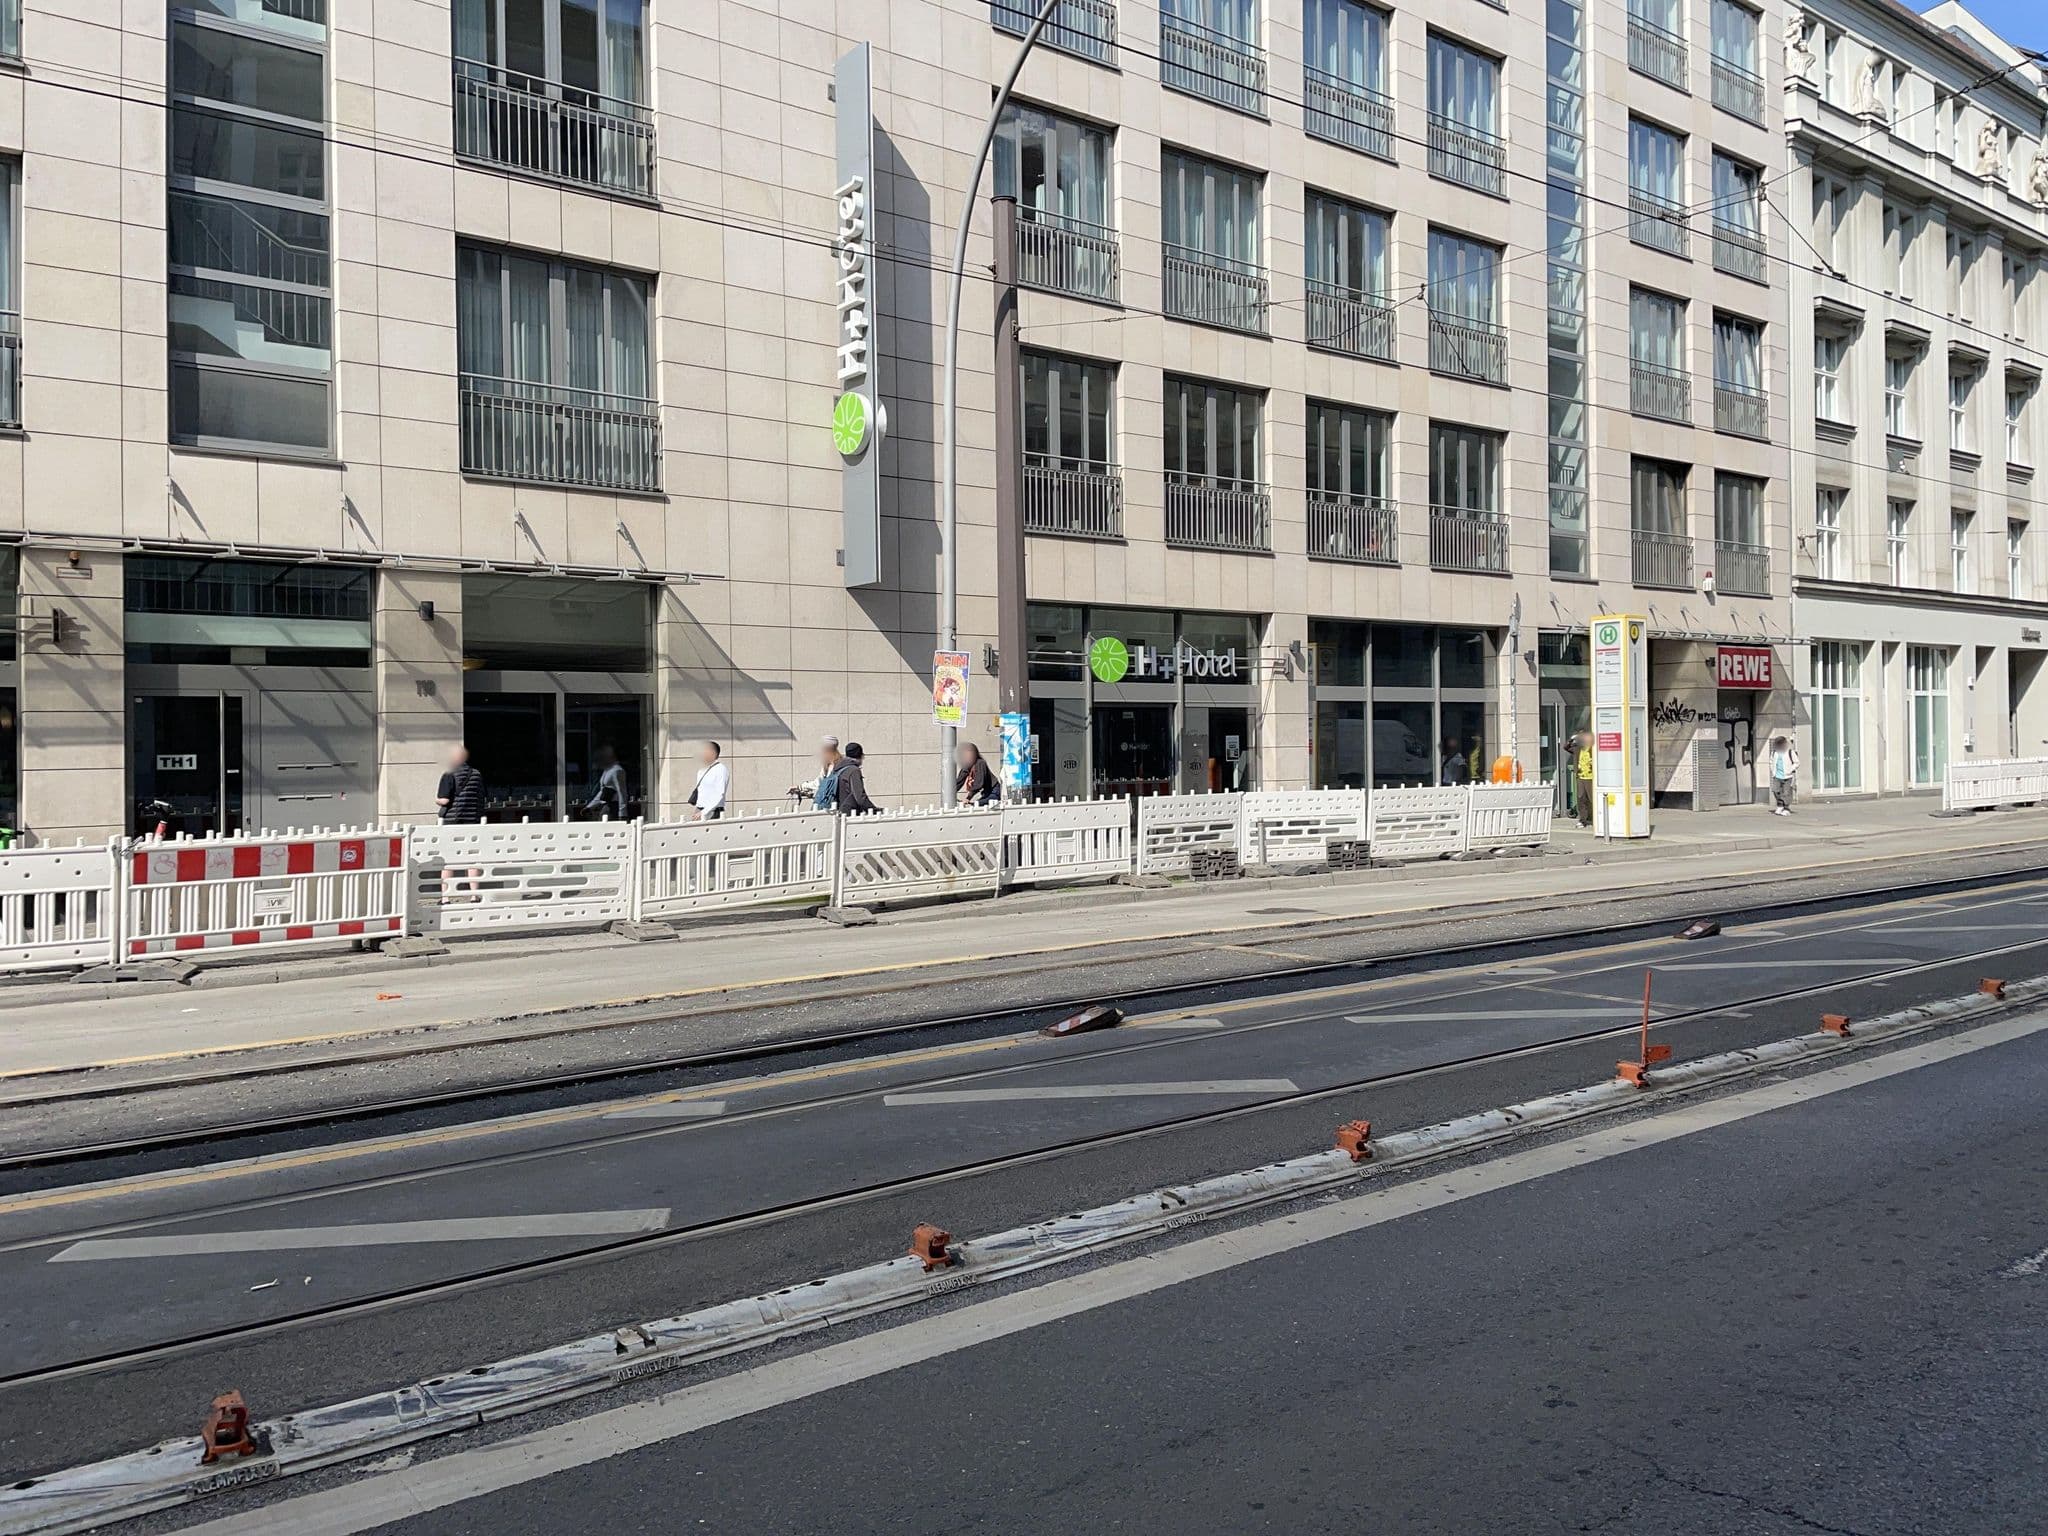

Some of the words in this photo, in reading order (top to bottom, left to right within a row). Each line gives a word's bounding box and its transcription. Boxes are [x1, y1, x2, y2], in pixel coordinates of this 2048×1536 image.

[1719, 653, 1770, 682] REWE
[926, 1276, 966, 1296] KLEMMFIX
[616, 1359, 666, 1383] KLEMMFIX
